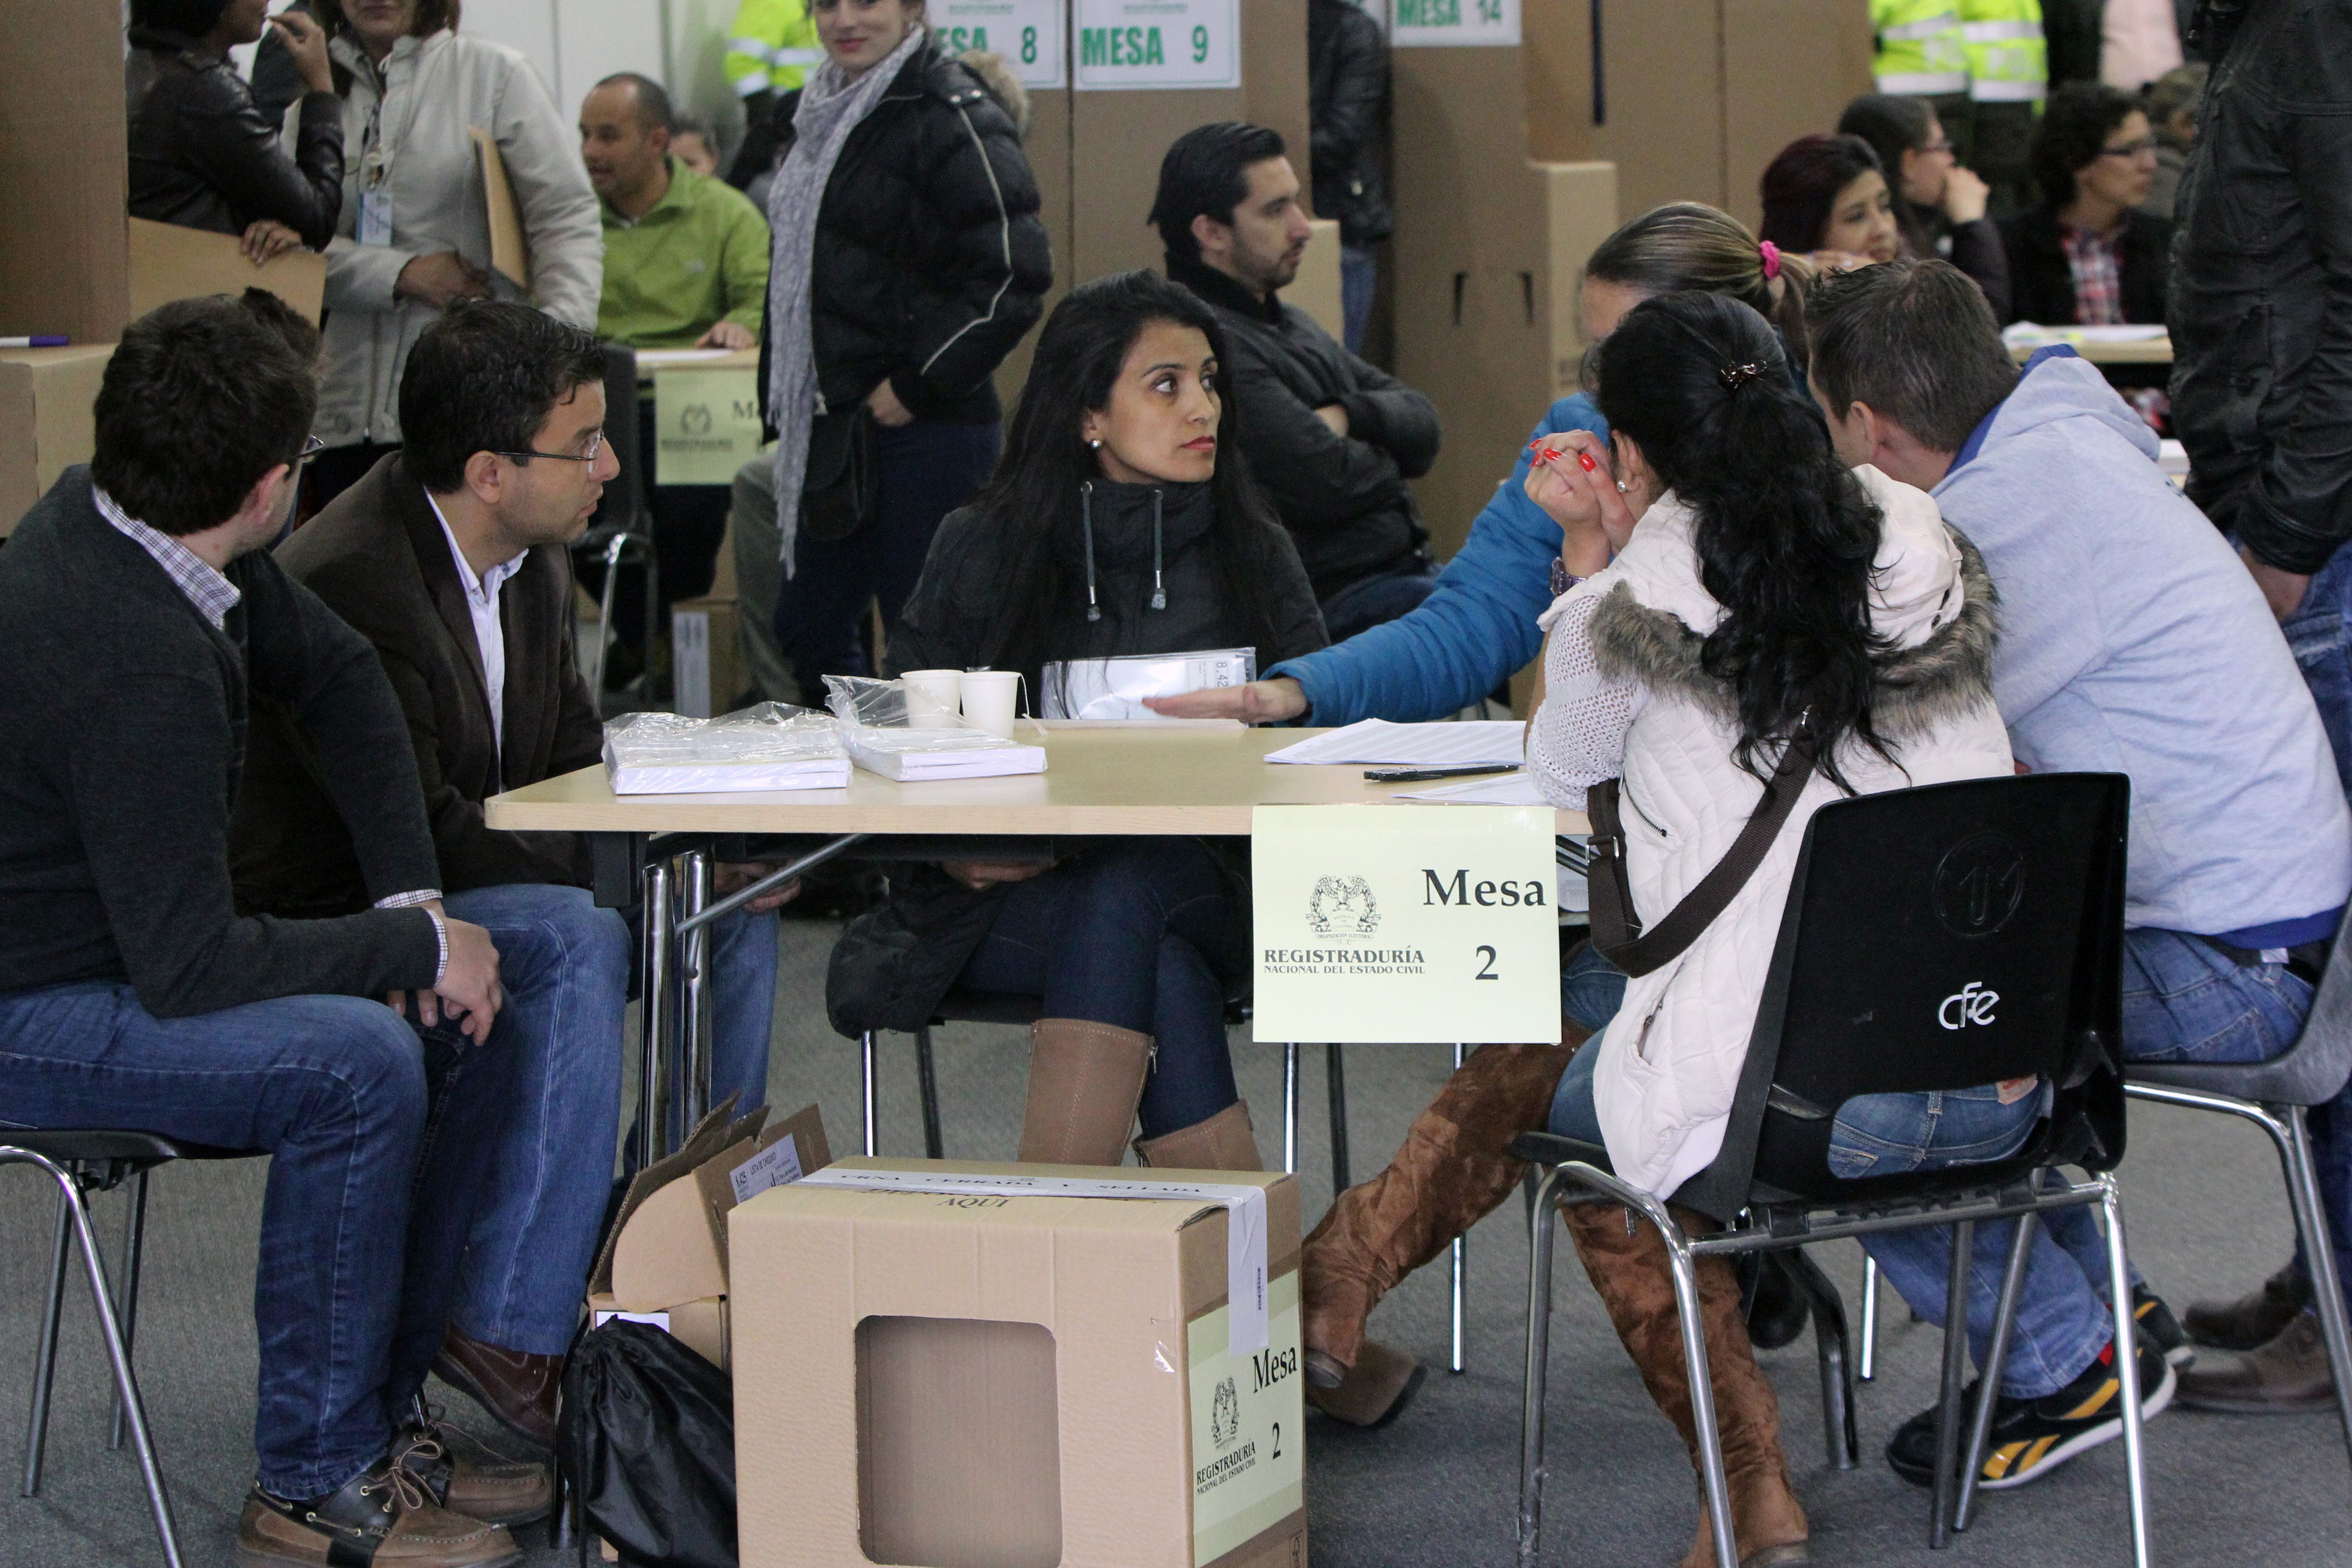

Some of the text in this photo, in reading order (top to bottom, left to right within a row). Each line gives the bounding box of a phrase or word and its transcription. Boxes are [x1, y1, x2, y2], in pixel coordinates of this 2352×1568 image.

[1022, 25, 1036, 64] 8
[1081, 24, 1208, 65] MESA 9
[1421, 869, 1547, 906] Mesa
[1264, 945, 1426, 963] REGISTRADURÍA
[1396, 965, 1426, 974] CIVIL
[1475, 945, 1499, 980] 2
[1253, 1347, 1297, 1394] Mesa
[1272, 1422, 1281, 1460] 2
[1197, 1438, 1256, 1485] REGISTRADURÍA
[1197, 1457, 1256, 1495] NACIONAL DEL ESTADO CIVIL
